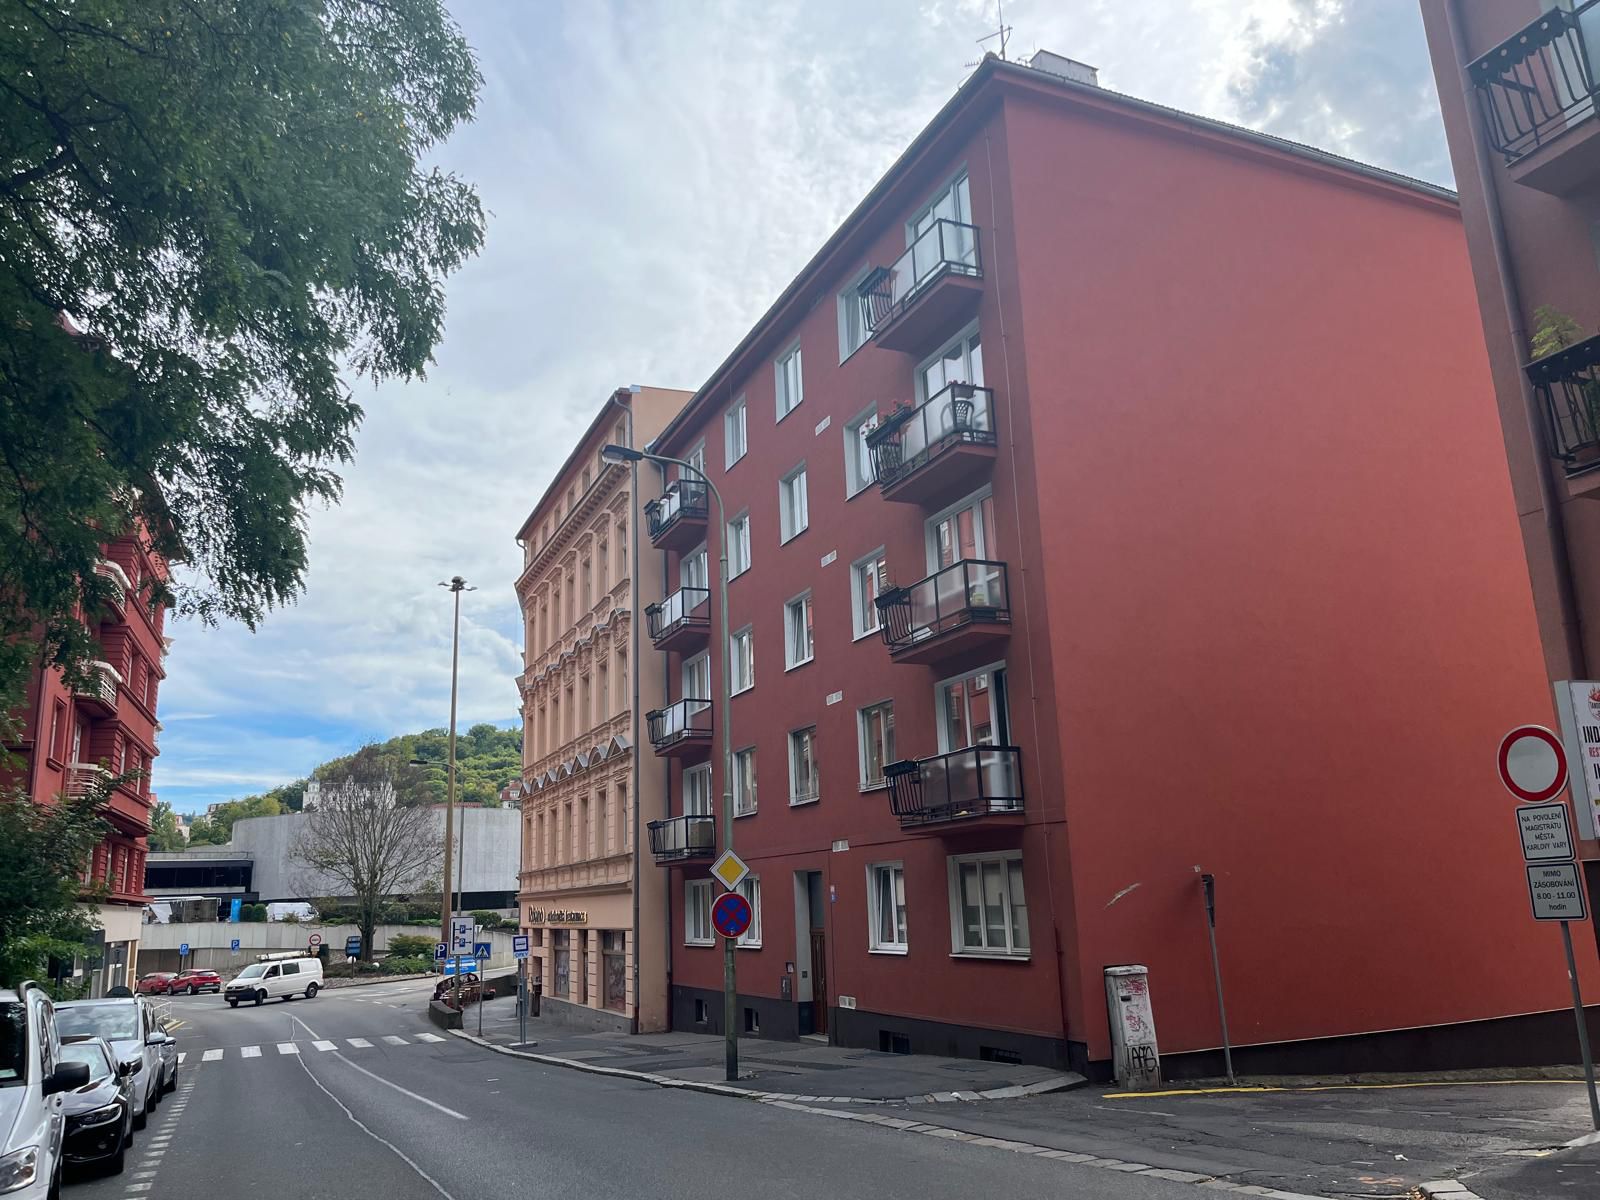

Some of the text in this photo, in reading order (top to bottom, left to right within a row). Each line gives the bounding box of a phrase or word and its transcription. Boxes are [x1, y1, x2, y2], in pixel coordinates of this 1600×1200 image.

[1583, 725, 1600, 743] IND
[1533, 811, 1562, 821] POVOLENÍ
[1526, 841, 1567, 851] KARLOVY VARY
[1542, 869, 1562, 877] MIMO
[1536, 892, 1551, 900] 8.00
[1557, 891, 1576, 899] 11.00
